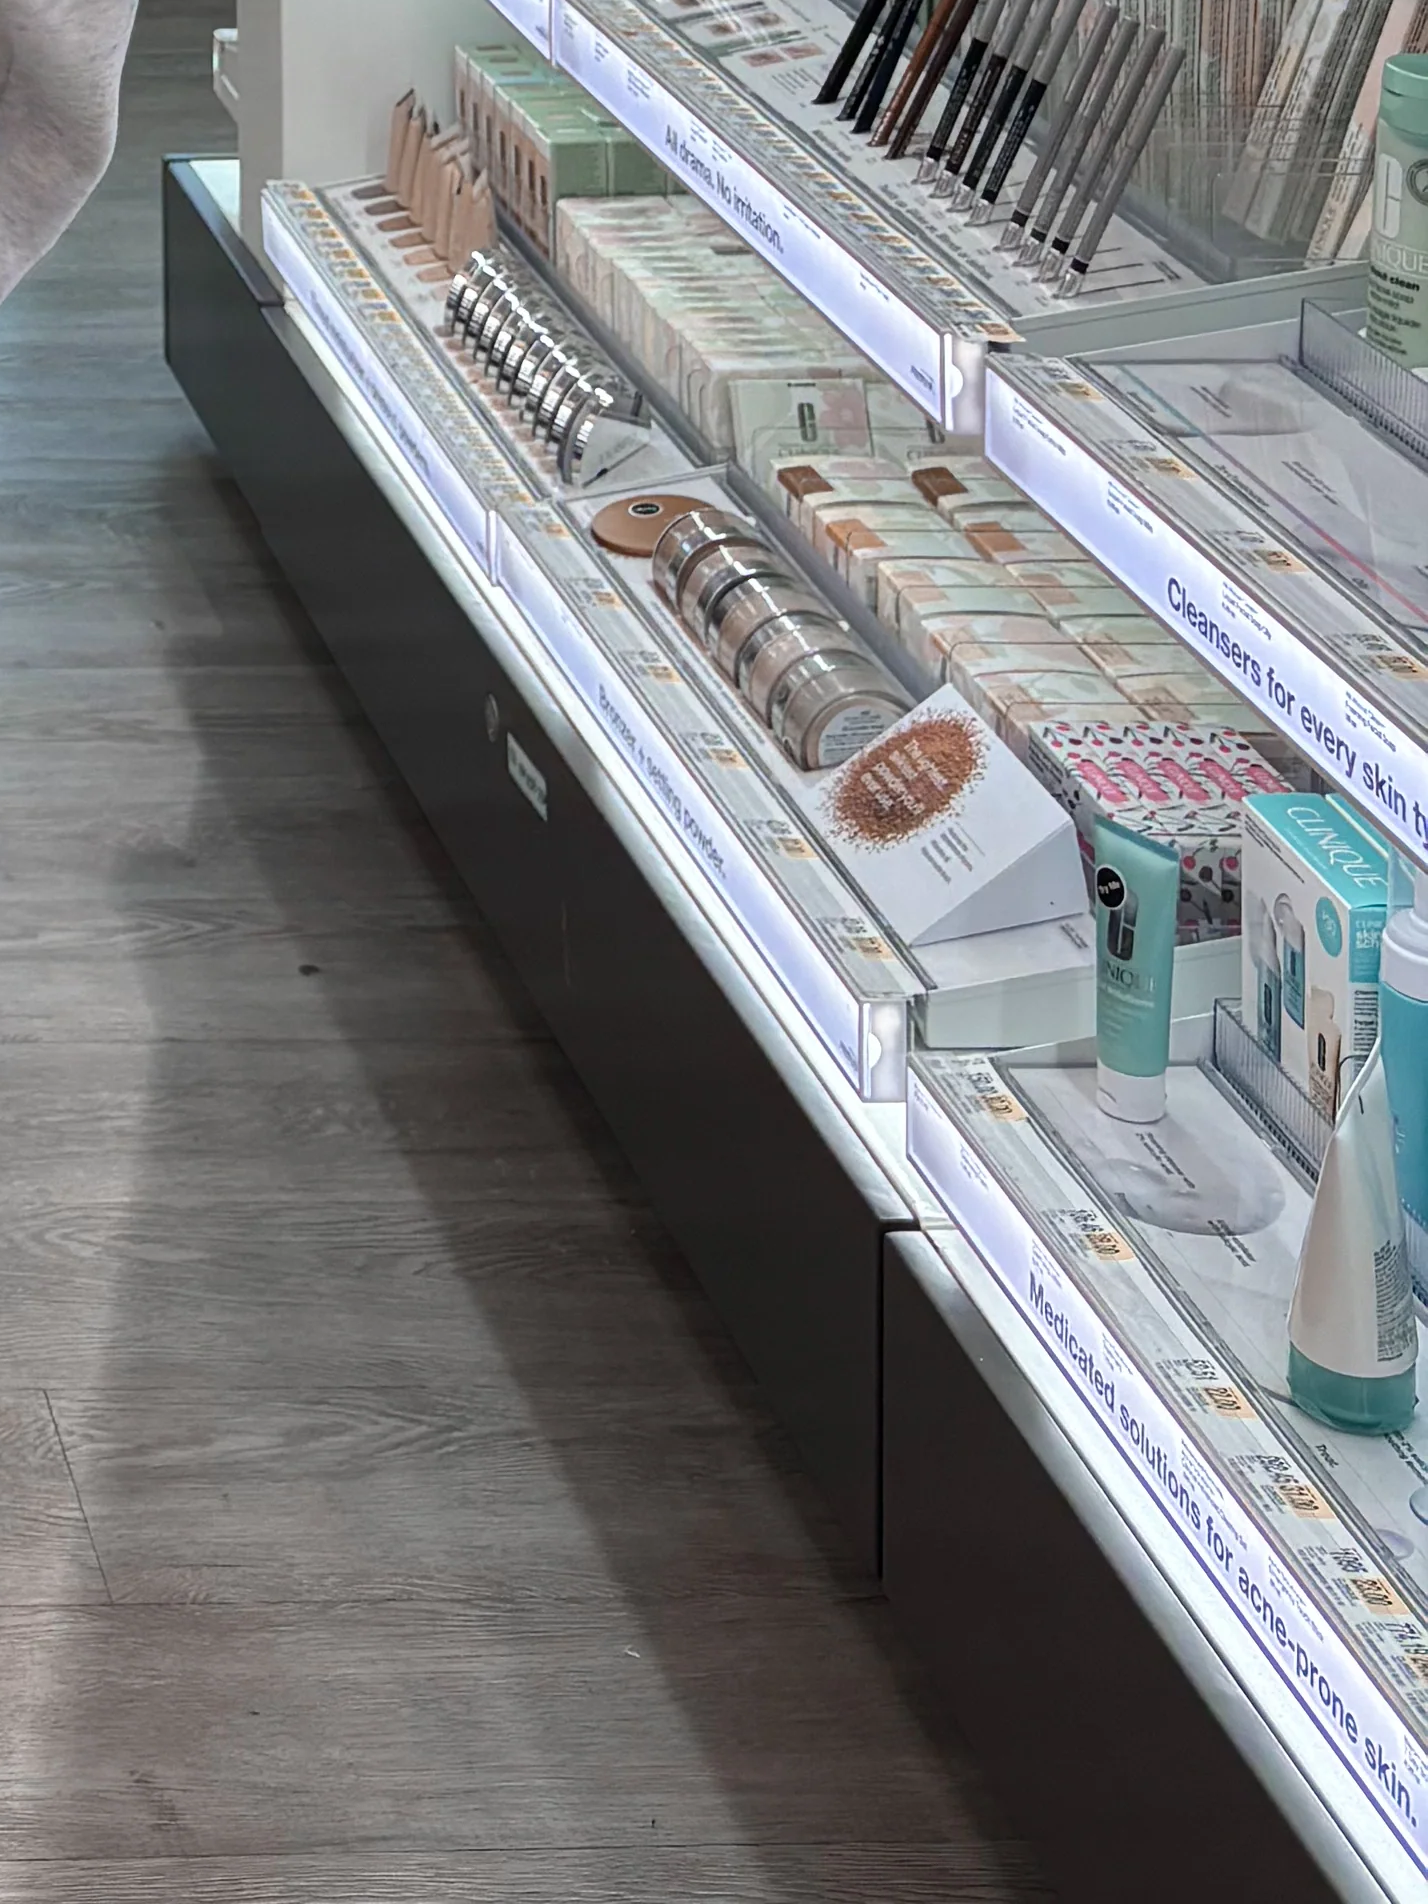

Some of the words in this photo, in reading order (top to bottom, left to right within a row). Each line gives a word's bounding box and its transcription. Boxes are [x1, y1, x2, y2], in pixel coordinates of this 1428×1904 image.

[665, 125, 678, 154] All
[680, 138, 714, 188] drama.
[717, 171, 732, 201] No
[733, 185, 784, 253] irritation.
[1167, 577, 1261, 686] Cleansers
[1266, 667, 1295, 714] for
[1300, 707, 1357, 778] every
[1362, 762, 1406, 823] skin
[1287, 807, 1388, 888] CLINIQUE
[1029, 1272, 1116, 1413] Medicated
[1118, 1404, 1201, 1531] solutions
[1206, 1515, 1233, 1572] for
[1239, 1567, 1358, 1743] acne-prone
[1364, 1733, 1417, 1828] skin.
